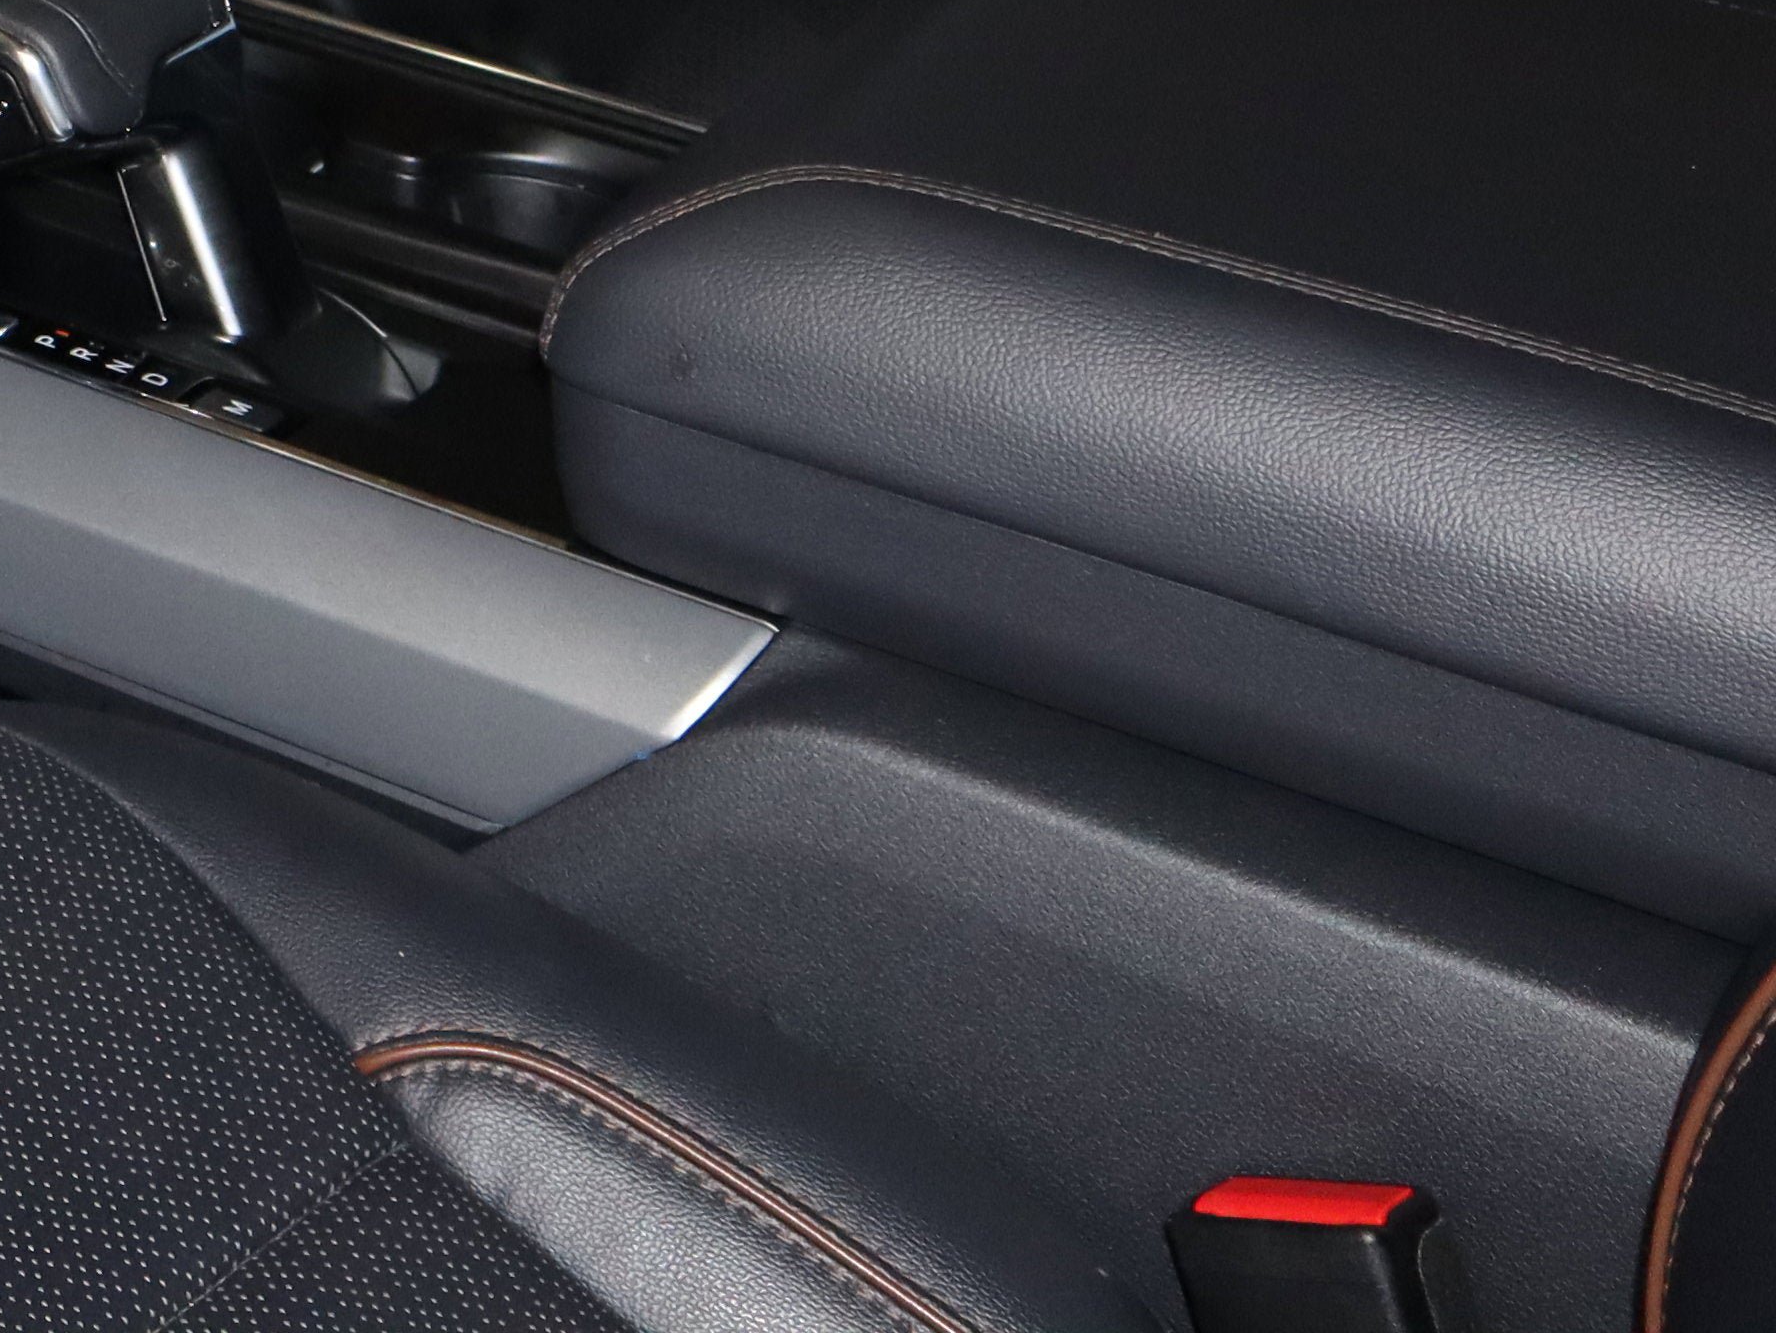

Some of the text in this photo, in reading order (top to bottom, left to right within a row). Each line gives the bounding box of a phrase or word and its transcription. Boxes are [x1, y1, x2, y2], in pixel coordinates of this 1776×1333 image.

[34, 334, 55, 349] P
[69, 346, 98, 362] R
[104, 358, 135, 374] N
[141, 372, 169, 387] D
